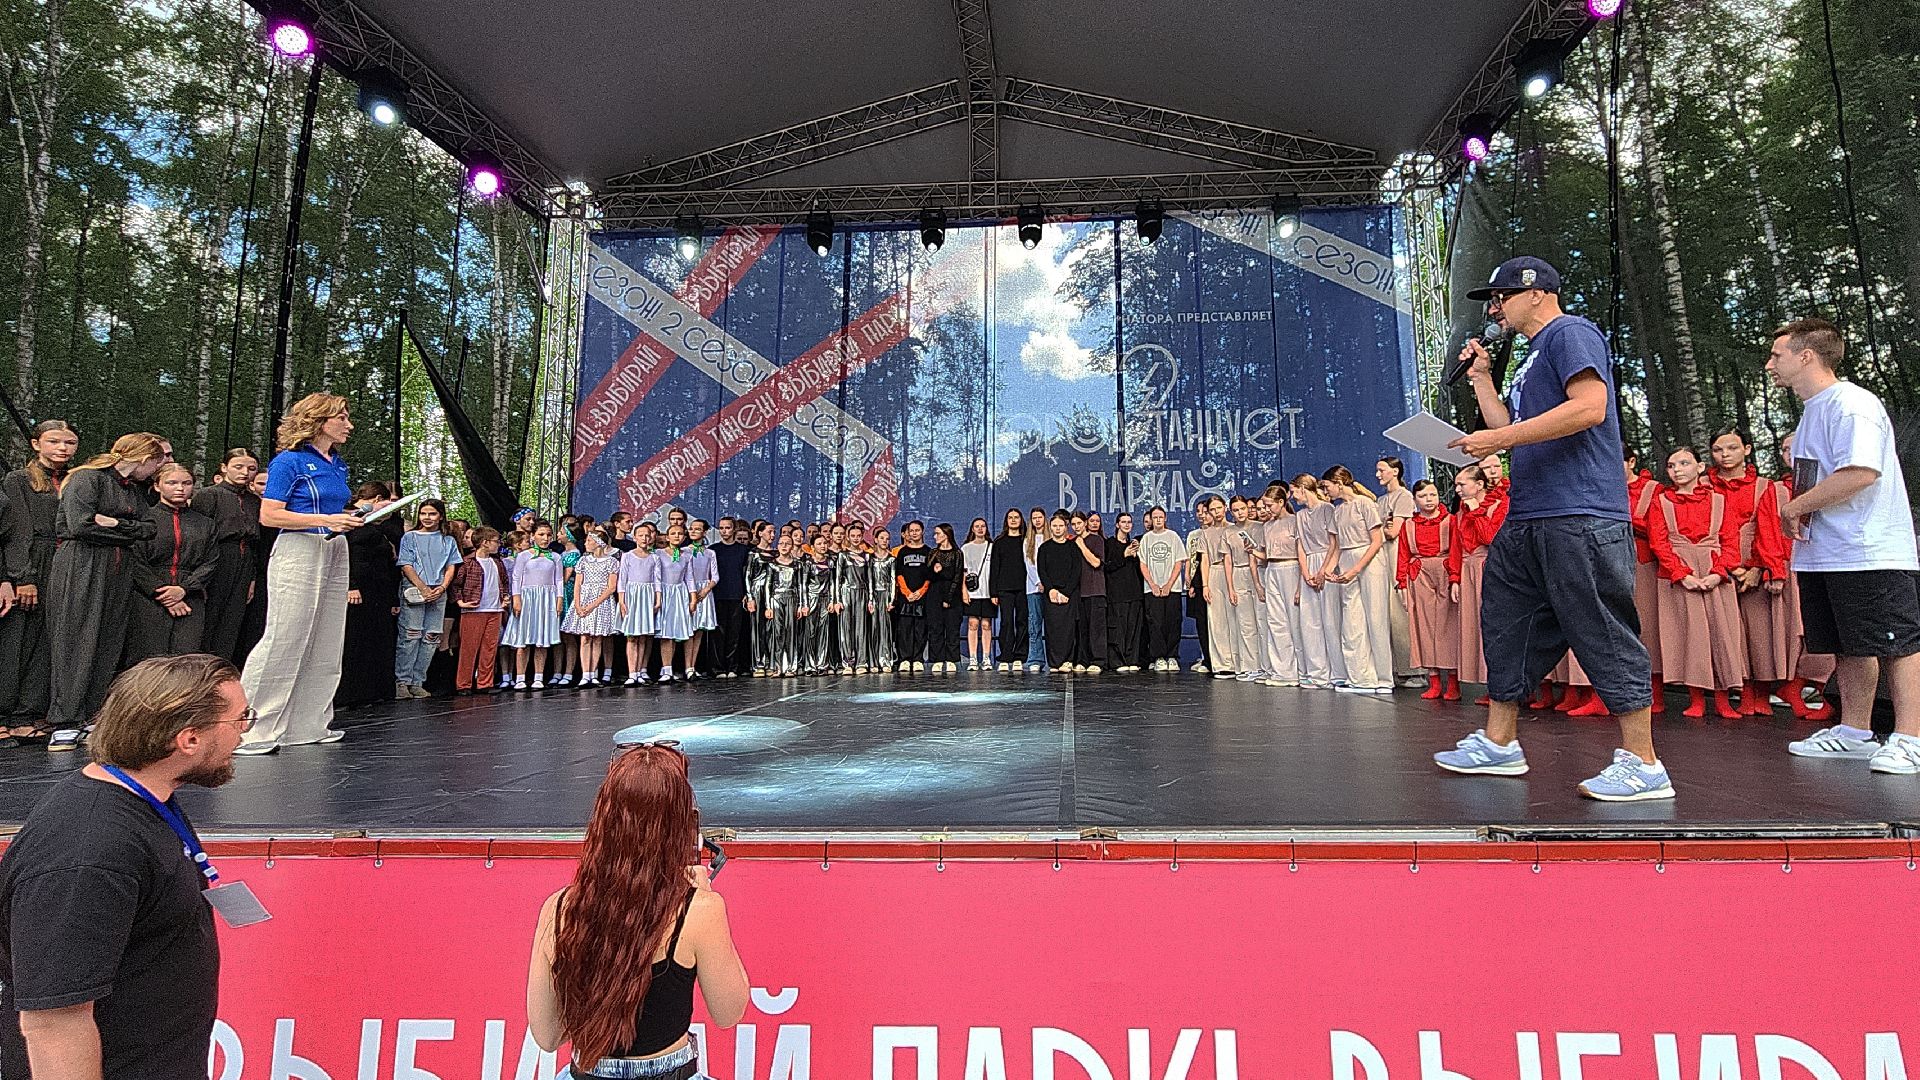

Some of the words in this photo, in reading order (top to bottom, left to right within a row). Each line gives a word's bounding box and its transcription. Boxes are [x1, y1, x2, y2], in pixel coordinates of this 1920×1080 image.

[588, 253, 664, 322] ЕЗОН!
[659, 311, 683, 336] 2
[1177, 310, 1272, 324] ПРЕДСТАВЛЯЕТ
[590, 343, 662, 426] ВЫБИРАЙ
[625, 435, 710, 509] ВЫБИРАЙ
[861, 312, 901, 347] ПАР
[1059, 472, 1078, 513] В
